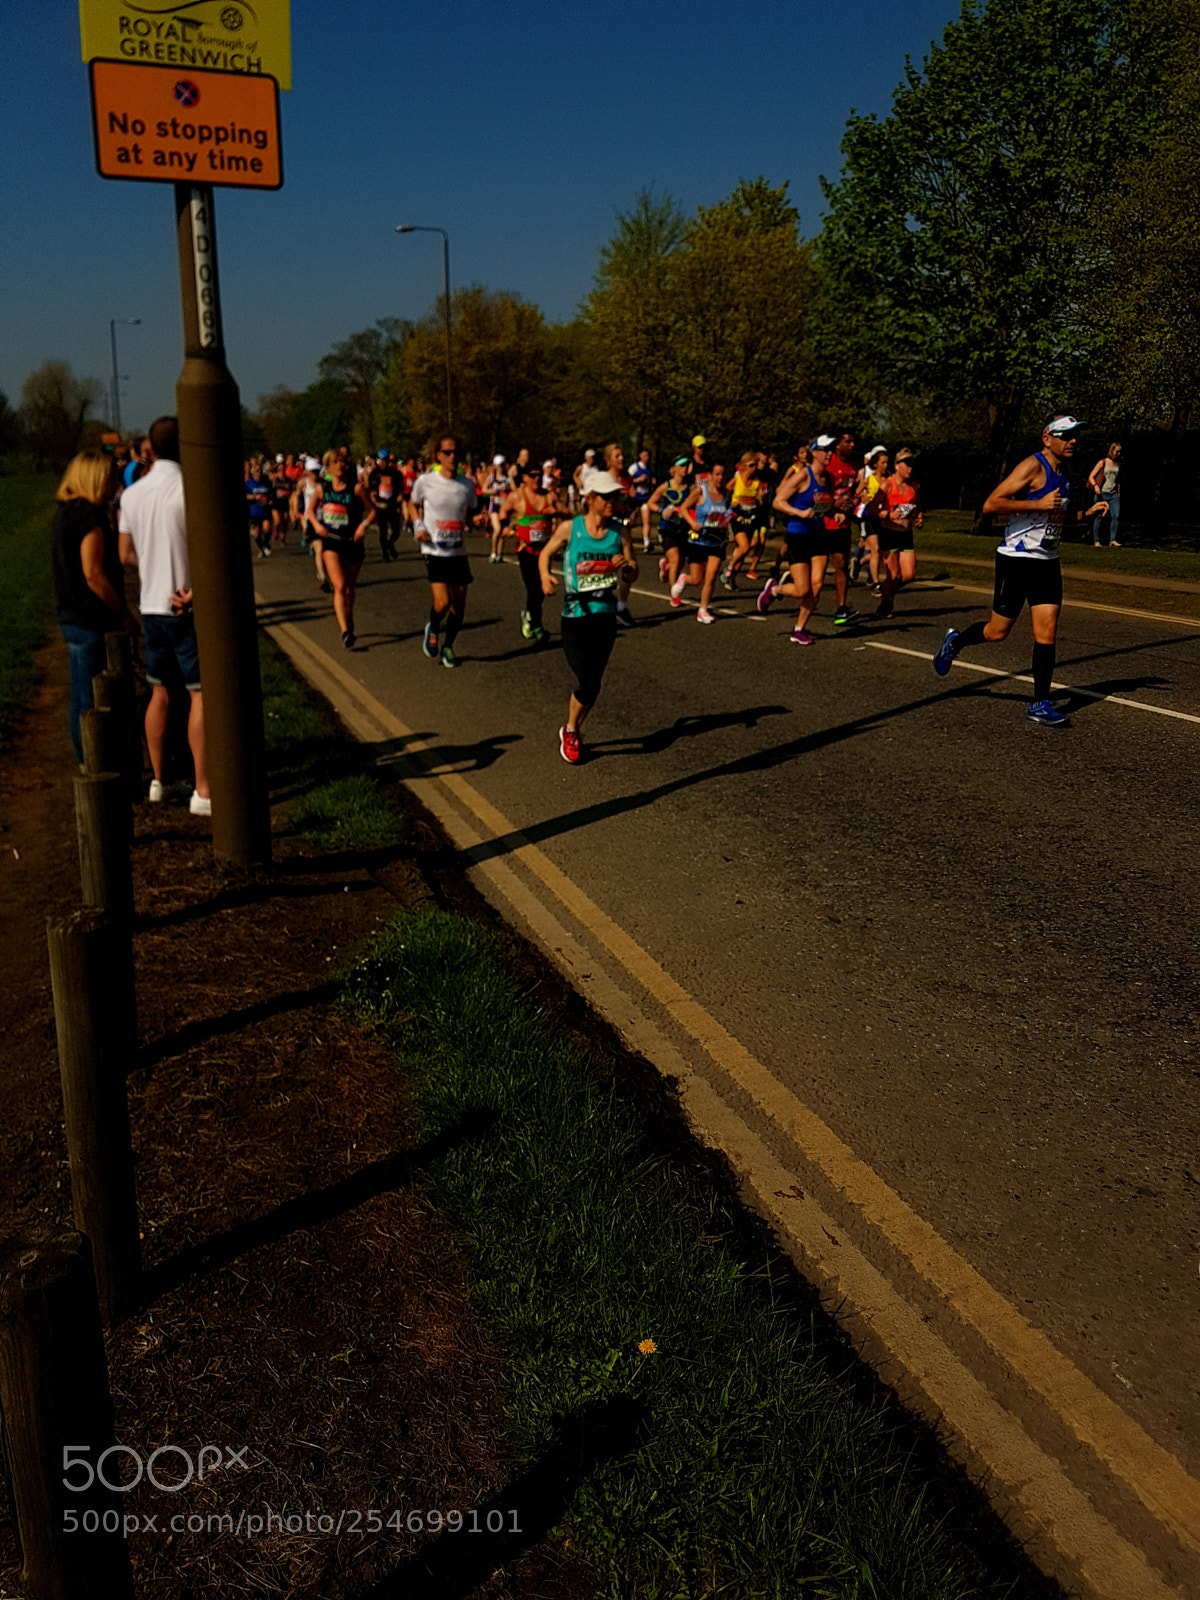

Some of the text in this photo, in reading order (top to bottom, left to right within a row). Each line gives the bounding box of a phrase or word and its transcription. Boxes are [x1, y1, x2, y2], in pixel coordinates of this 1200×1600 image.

[118, 15, 194, 44] ROYAL
[119, 37, 262, 74] GREENWICH
[108, 111, 268, 149] No stopping
[116, 143, 263, 173] at any time
